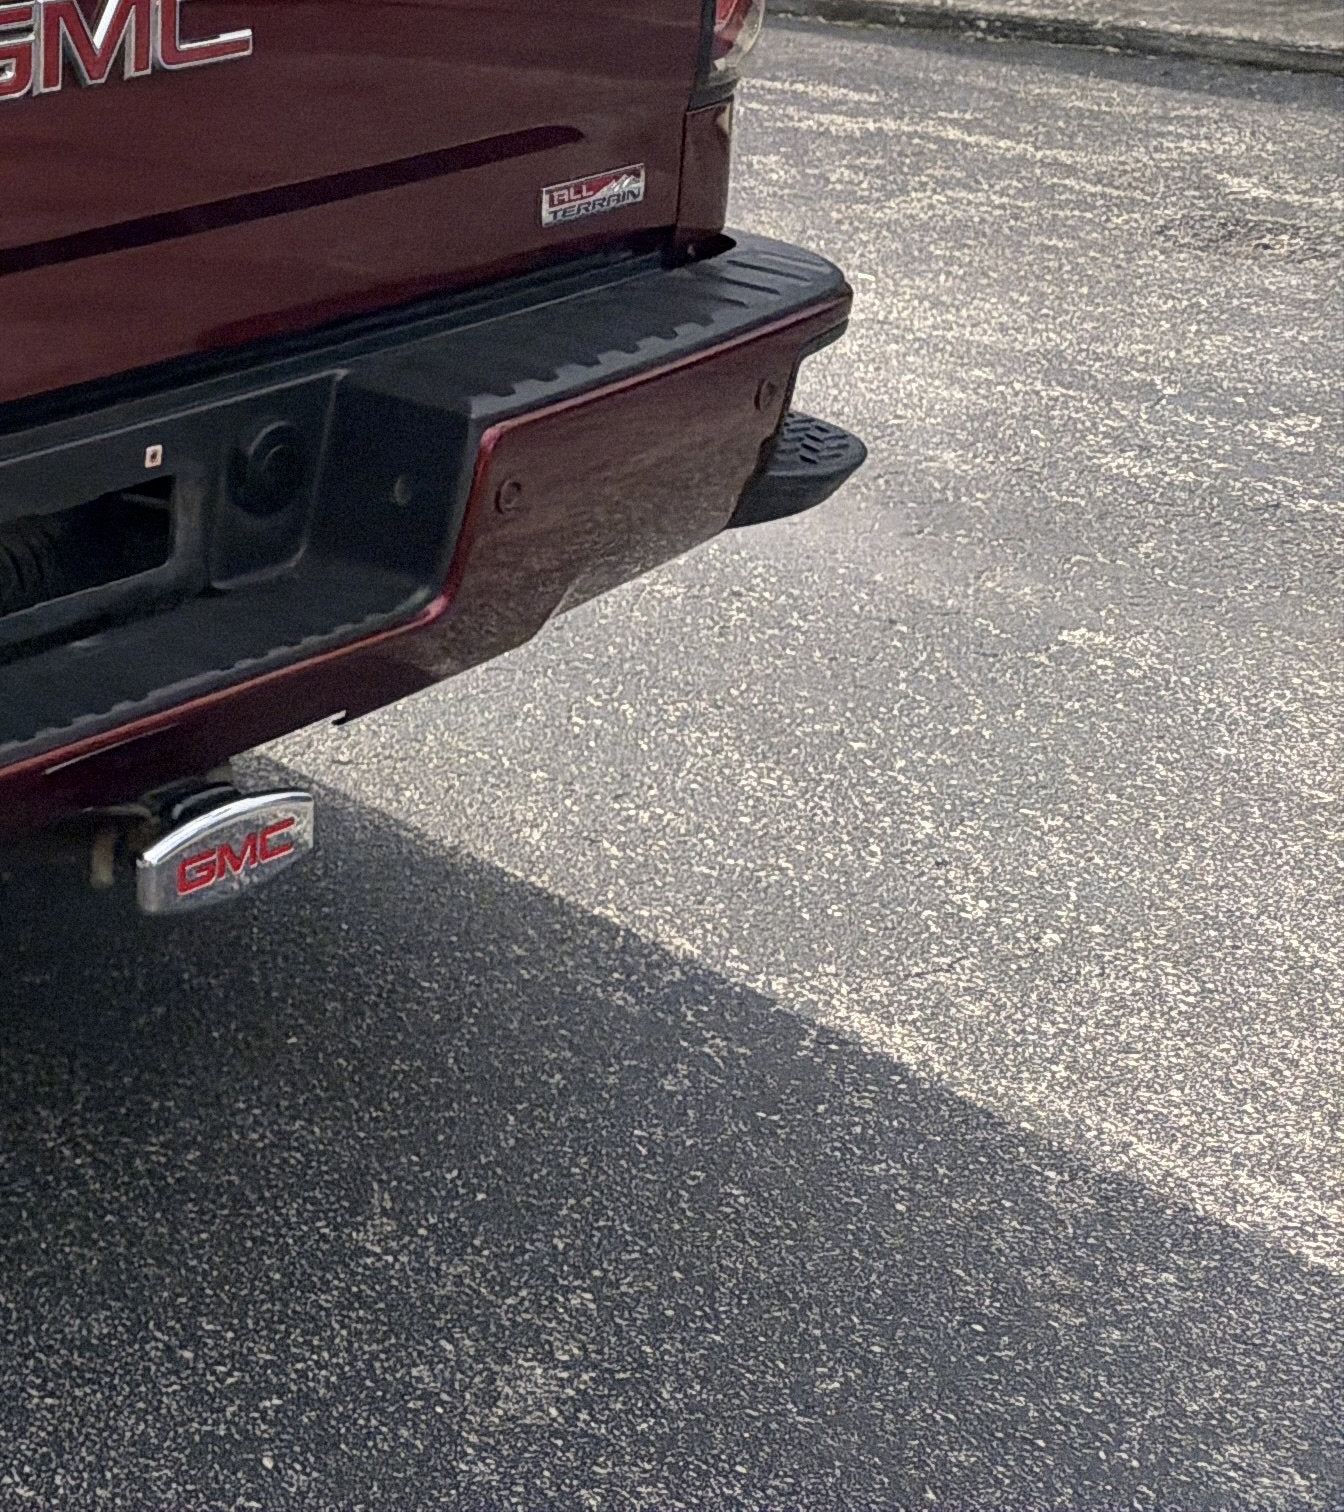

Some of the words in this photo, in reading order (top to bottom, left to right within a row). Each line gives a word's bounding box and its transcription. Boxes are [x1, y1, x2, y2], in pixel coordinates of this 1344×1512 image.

[548, 188, 641, 221] TERRAIN
[552, 184, 595, 205] ALL
[176, 816, 297, 896] GMC
